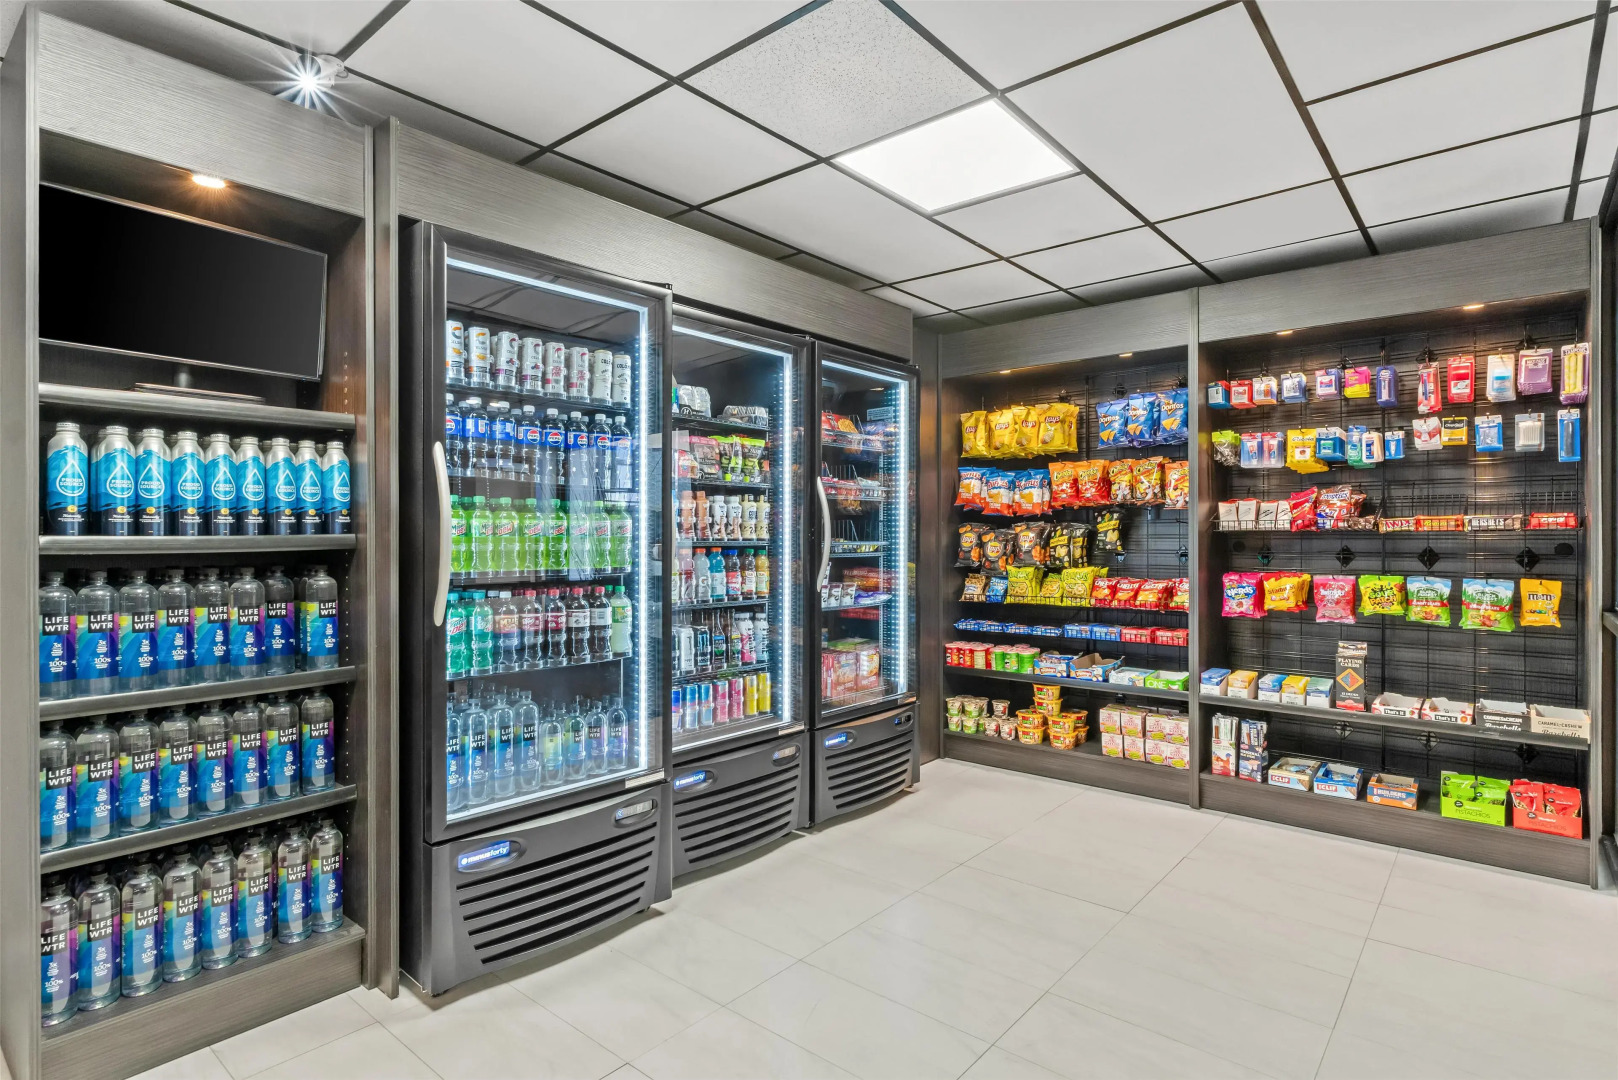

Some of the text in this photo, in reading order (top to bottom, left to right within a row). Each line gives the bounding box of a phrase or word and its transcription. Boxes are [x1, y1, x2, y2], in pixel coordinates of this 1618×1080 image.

[1161, 403, 1184, 411] Doritos
[1369, 589, 1394, 598] SOUR
[1368, 595, 1397, 606] PATCH
[210, 606, 228, 614] LIFE
[268, 602, 286, 610] LIFE
[168, 608, 190, 616] LIFE
[240, 608, 259, 616] LIFE
[45, 616, 69, 624] LIFE
[90, 614, 113, 622] LIFE
[134, 614, 155, 622] LIFE
[168, 616, 189, 624] WTR
[210, 613, 228, 621] WTR
[240, 615, 259, 623] WTR
[44, 624, 69, 632] WTR
[90, 622, 113, 630] WTR
[134, 622, 155, 630] WTR
[1146, 680, 1167, 689] ONE
[311, 722, 329, 730] LIFE
[280, 727, 297, 736] LIFE
[311, 729, 329, 737] WTR
[242, 732, 261, 741] LIFE
[280, 734, 297, 743] WTR
[207, 741, 227, 750] LIFE
[241, 740, 261, 748] WTR
[173, 744, 193, 754] LIFE
[207, 749, 227, 757] WTR
[134, 752, 156, 762] LIFE
[173, 752, 193, 762] WTR
[90, 760, 113, 771] LIFE
[134, 760, 156, 770] WTR
[48, 767, 72, 778] LIFE
[90, 769, 113, 779] WTR
[48, 776, 72, 786] WTR
[1276, 775, 1289, 783] CLIF
[1456, 808, 1491, 819] PISTACHIOS
[1528, 820, 1567, 832] PISTACHIOS
[468, 846, 509, 864] minusforty
[323, 856, 340, 865] LIFE
[288, 864, 306, 874] LIFE
[323, 863, 340, 872] WTR
[288, 871, 306, 880] WTR
[250, 876, 269, 886] LIFE
[213, 886, 233, 896] LIFE
[250, 883, 269, 893] WTR
[178, 894, 198, 906] LIFE
[213, 894, 233, 904] WTR
[137, 906, 159, 919] LIFE
[178, 902, 199, 914] WTR
[89, 918, 113, 930] LIFE
[137, 914, 159, 927] WTR
[89, 927, 113, 939] WTR
[40, 933, 66, 944] LIFE
